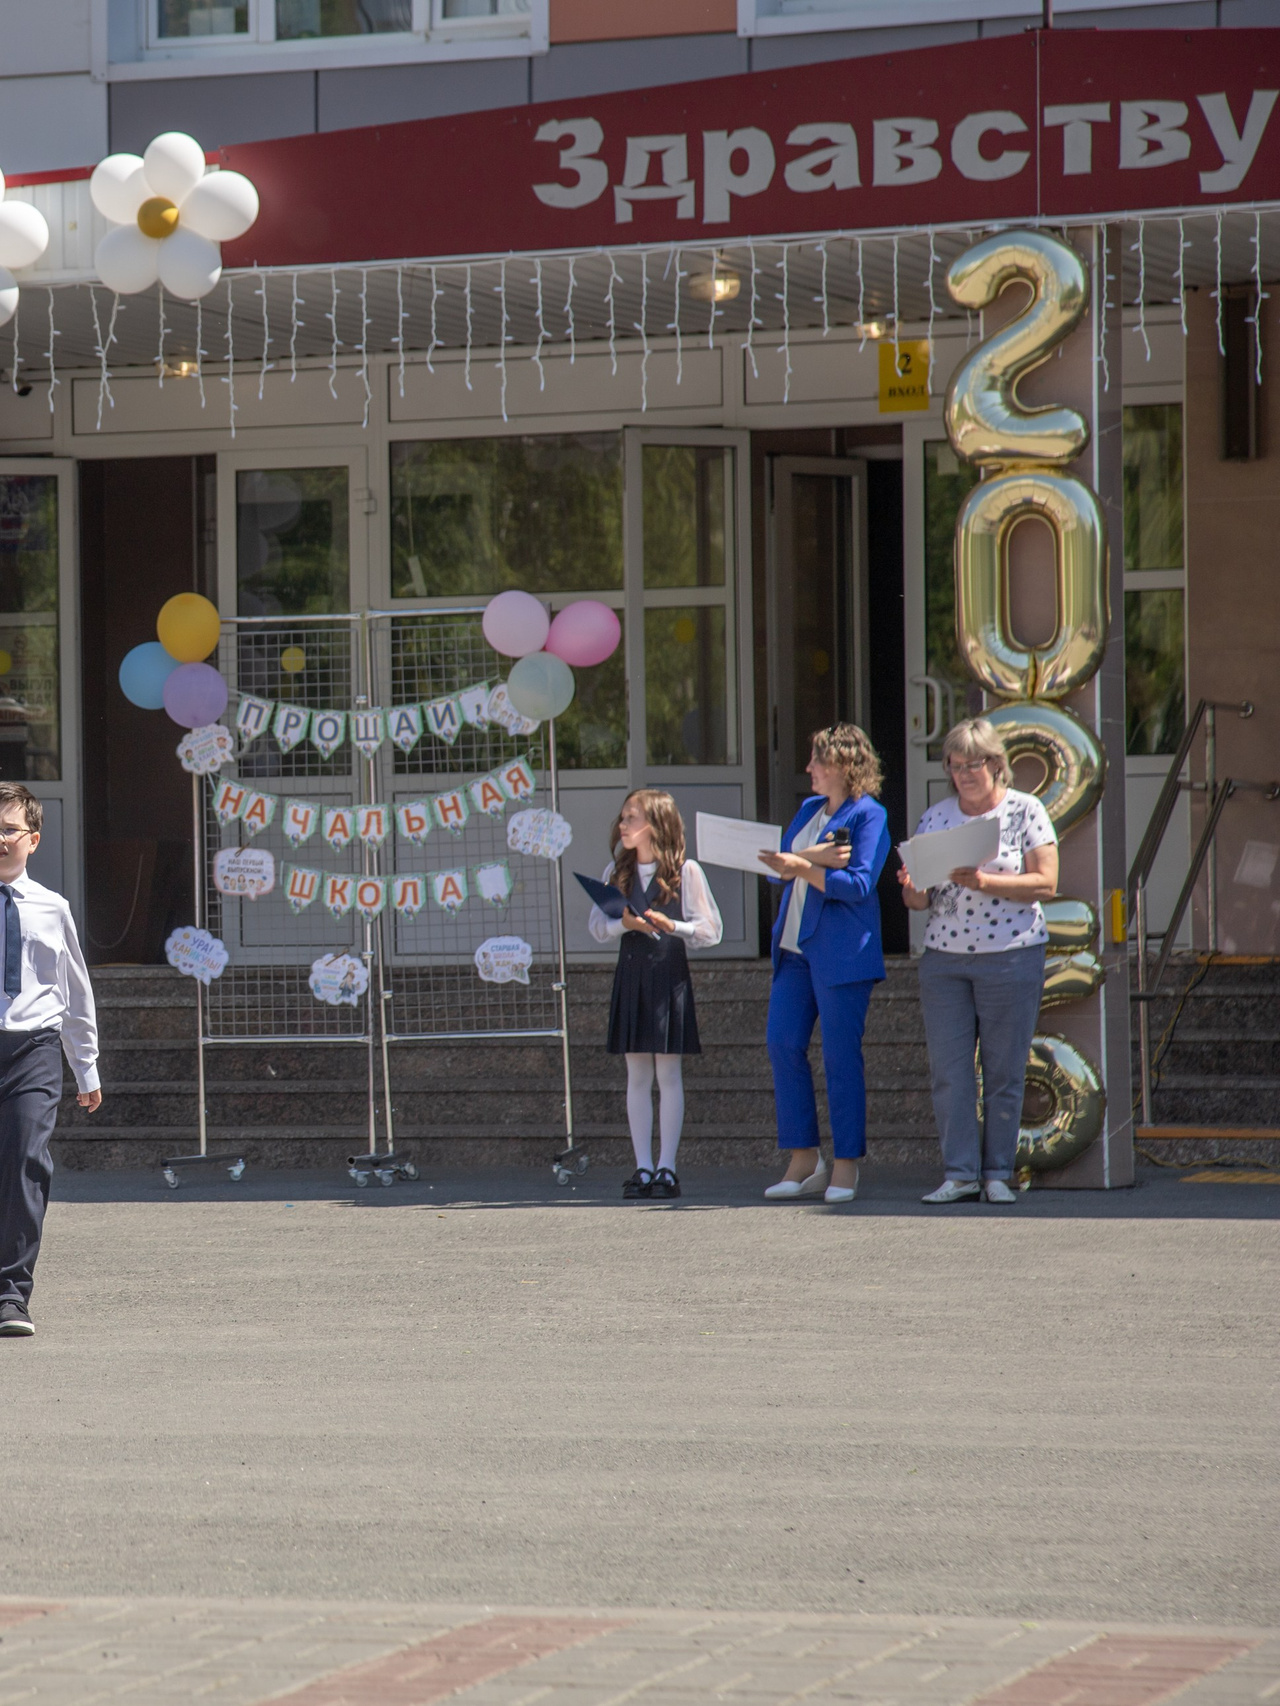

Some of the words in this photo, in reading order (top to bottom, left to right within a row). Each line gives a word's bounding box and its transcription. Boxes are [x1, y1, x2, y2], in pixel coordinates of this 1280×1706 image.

[531, 88, 1280, 223] Здравству
[899, 352, 912, 375] 2
[220, 766, 531, 839] НАЧАЛЬНАЯ
[289, 870, 463, 907] ШКОЛА
[172, 941, 222, 971] КАНИКУЛЫ!
[191, 936, 214, 955] УРА!
[491, 944, 520, 952] СТАРШАЯ
